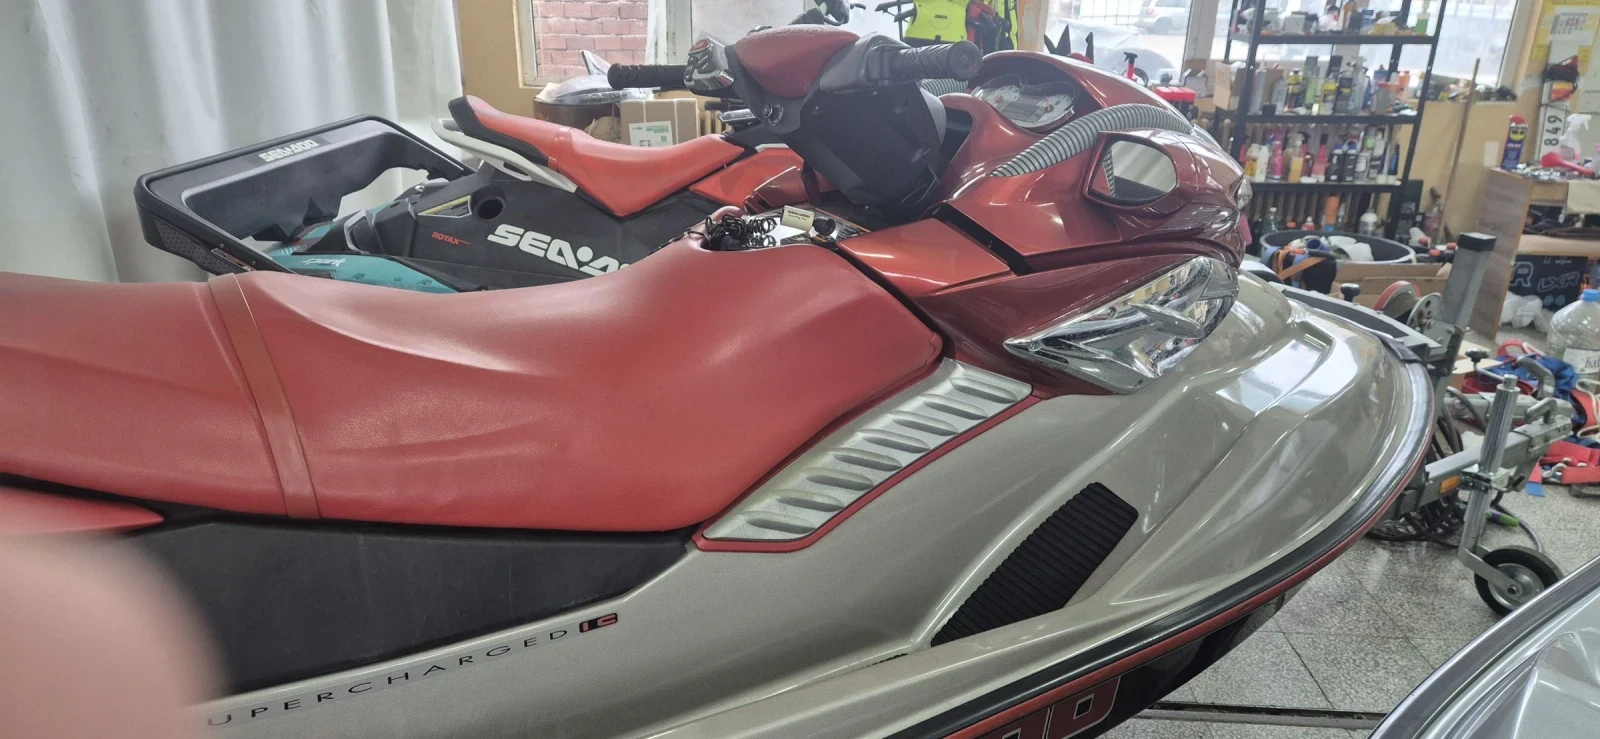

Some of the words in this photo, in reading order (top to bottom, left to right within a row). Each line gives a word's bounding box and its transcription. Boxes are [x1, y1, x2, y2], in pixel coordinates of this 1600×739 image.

[1544, 115, 1562, 146] 849
[431, 231, 460, 245] ROTAX
[207, 629, 569, 727] UPERCHARGED
